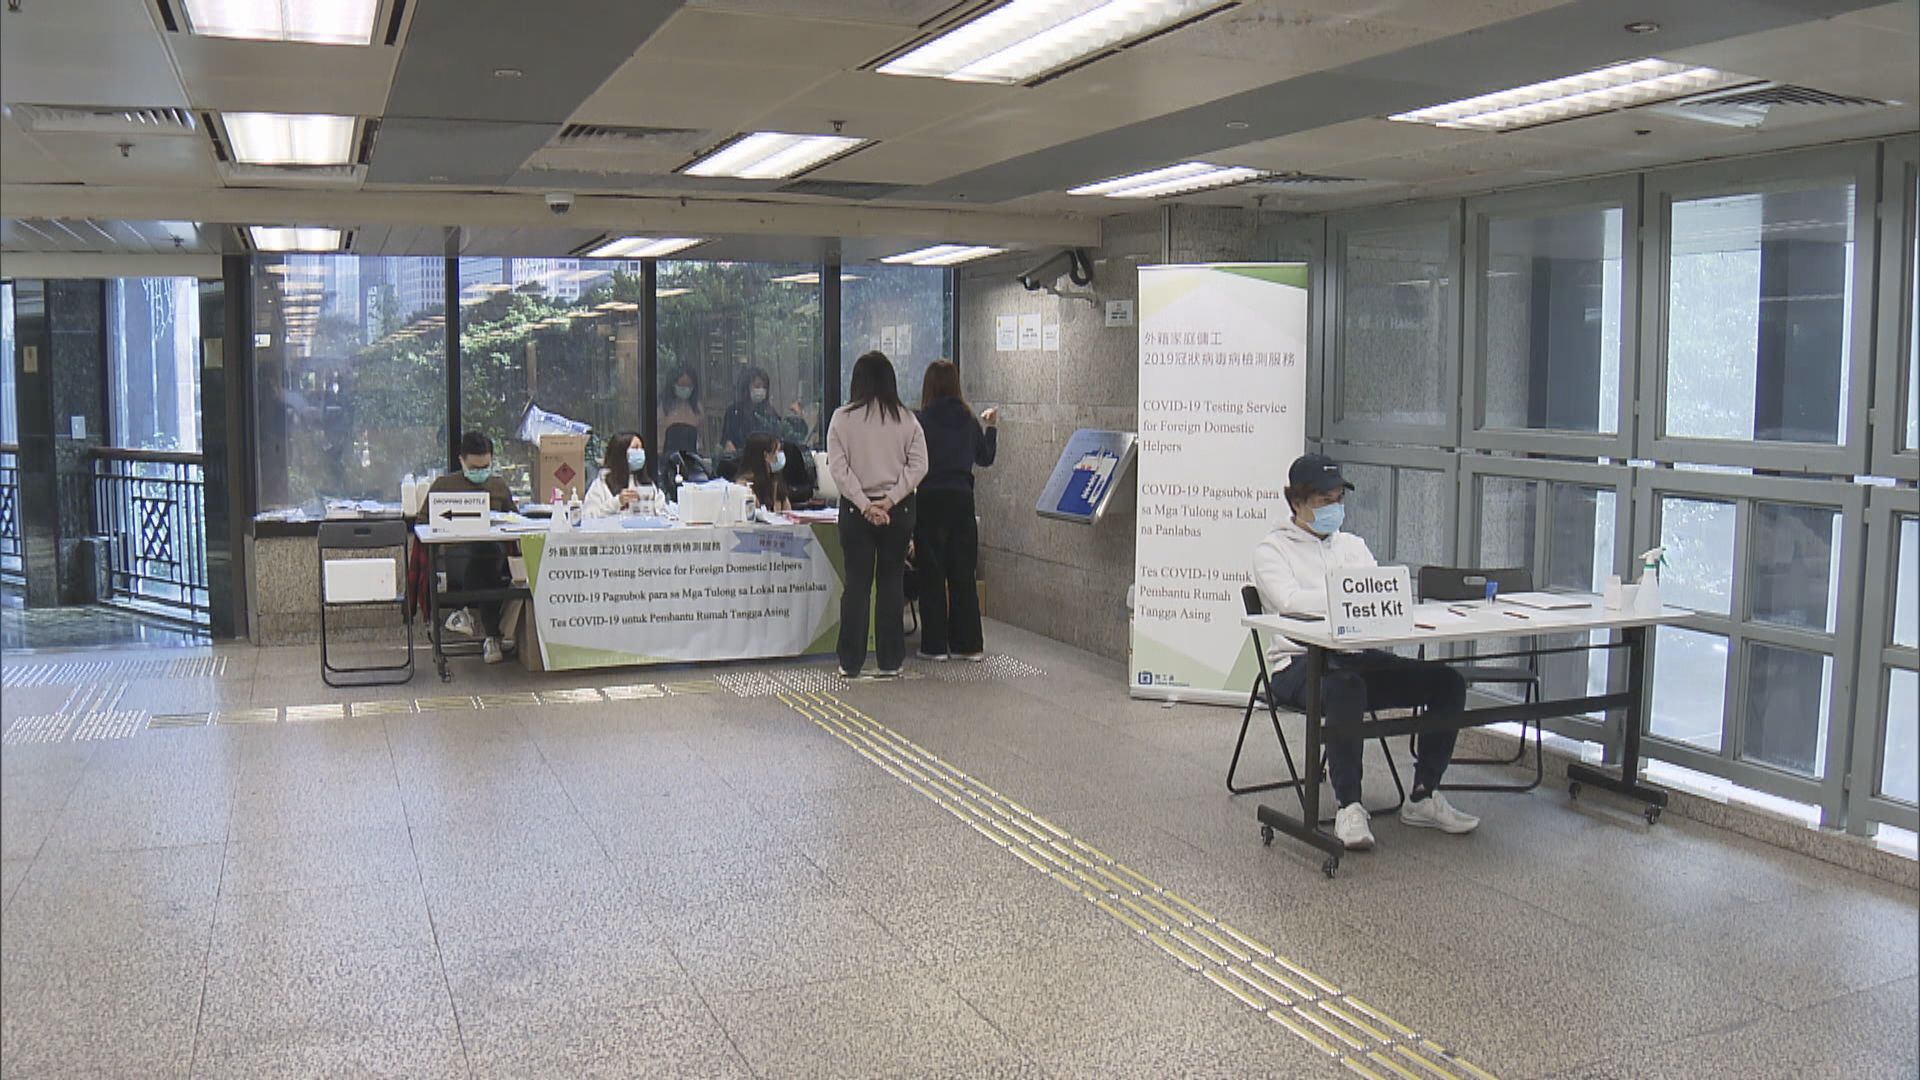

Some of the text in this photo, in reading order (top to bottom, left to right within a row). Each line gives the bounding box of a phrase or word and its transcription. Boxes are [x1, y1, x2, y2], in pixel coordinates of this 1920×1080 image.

[1143, 400, 1287, 415] COVID-19 Testing Service
[1143, 420, 1255, 435] for Foreign Domestic
[1143, 440, 1182, 454] Helpers
[1141, 484, 1280, 501] COVID-19 Pagsubok para
[1141, 506, 1267, 520] sa Mga Tulong sa Lokal
[1140, 525, 1202, 537] na Panlabas
[548, 560, 802, 581] COVID-19 Testing Service for Foreign Domestic Helpers
[1139, 566, 1253, 582] Tes COVID-19 untuk
[549, 592, 600, 604] COVID-19
[602, 590, 645, 603] Pagsubok
[648, 591, 668, 602] para
[682, 588, 703, 601] Mga
[704, 586, 736, 598] Tulong
[738, 587, 748, 596] sa
[750, 583, 775, 596] Lokal
[777, 585, 788, 594] na
[789, 581, 827, 593] Panlabas
[1342, 577, 1399, 593] Collect
[1139, 587, 1231, 602] Pembantu Rumah
[551, 606, 790, 628] Tes COVID-19 untuk Pembantu Rumah Tangga Asing
[1139, 606, 1212, 623] Tangga Asing
[1341, 600, 1404, 618] Test Kit
